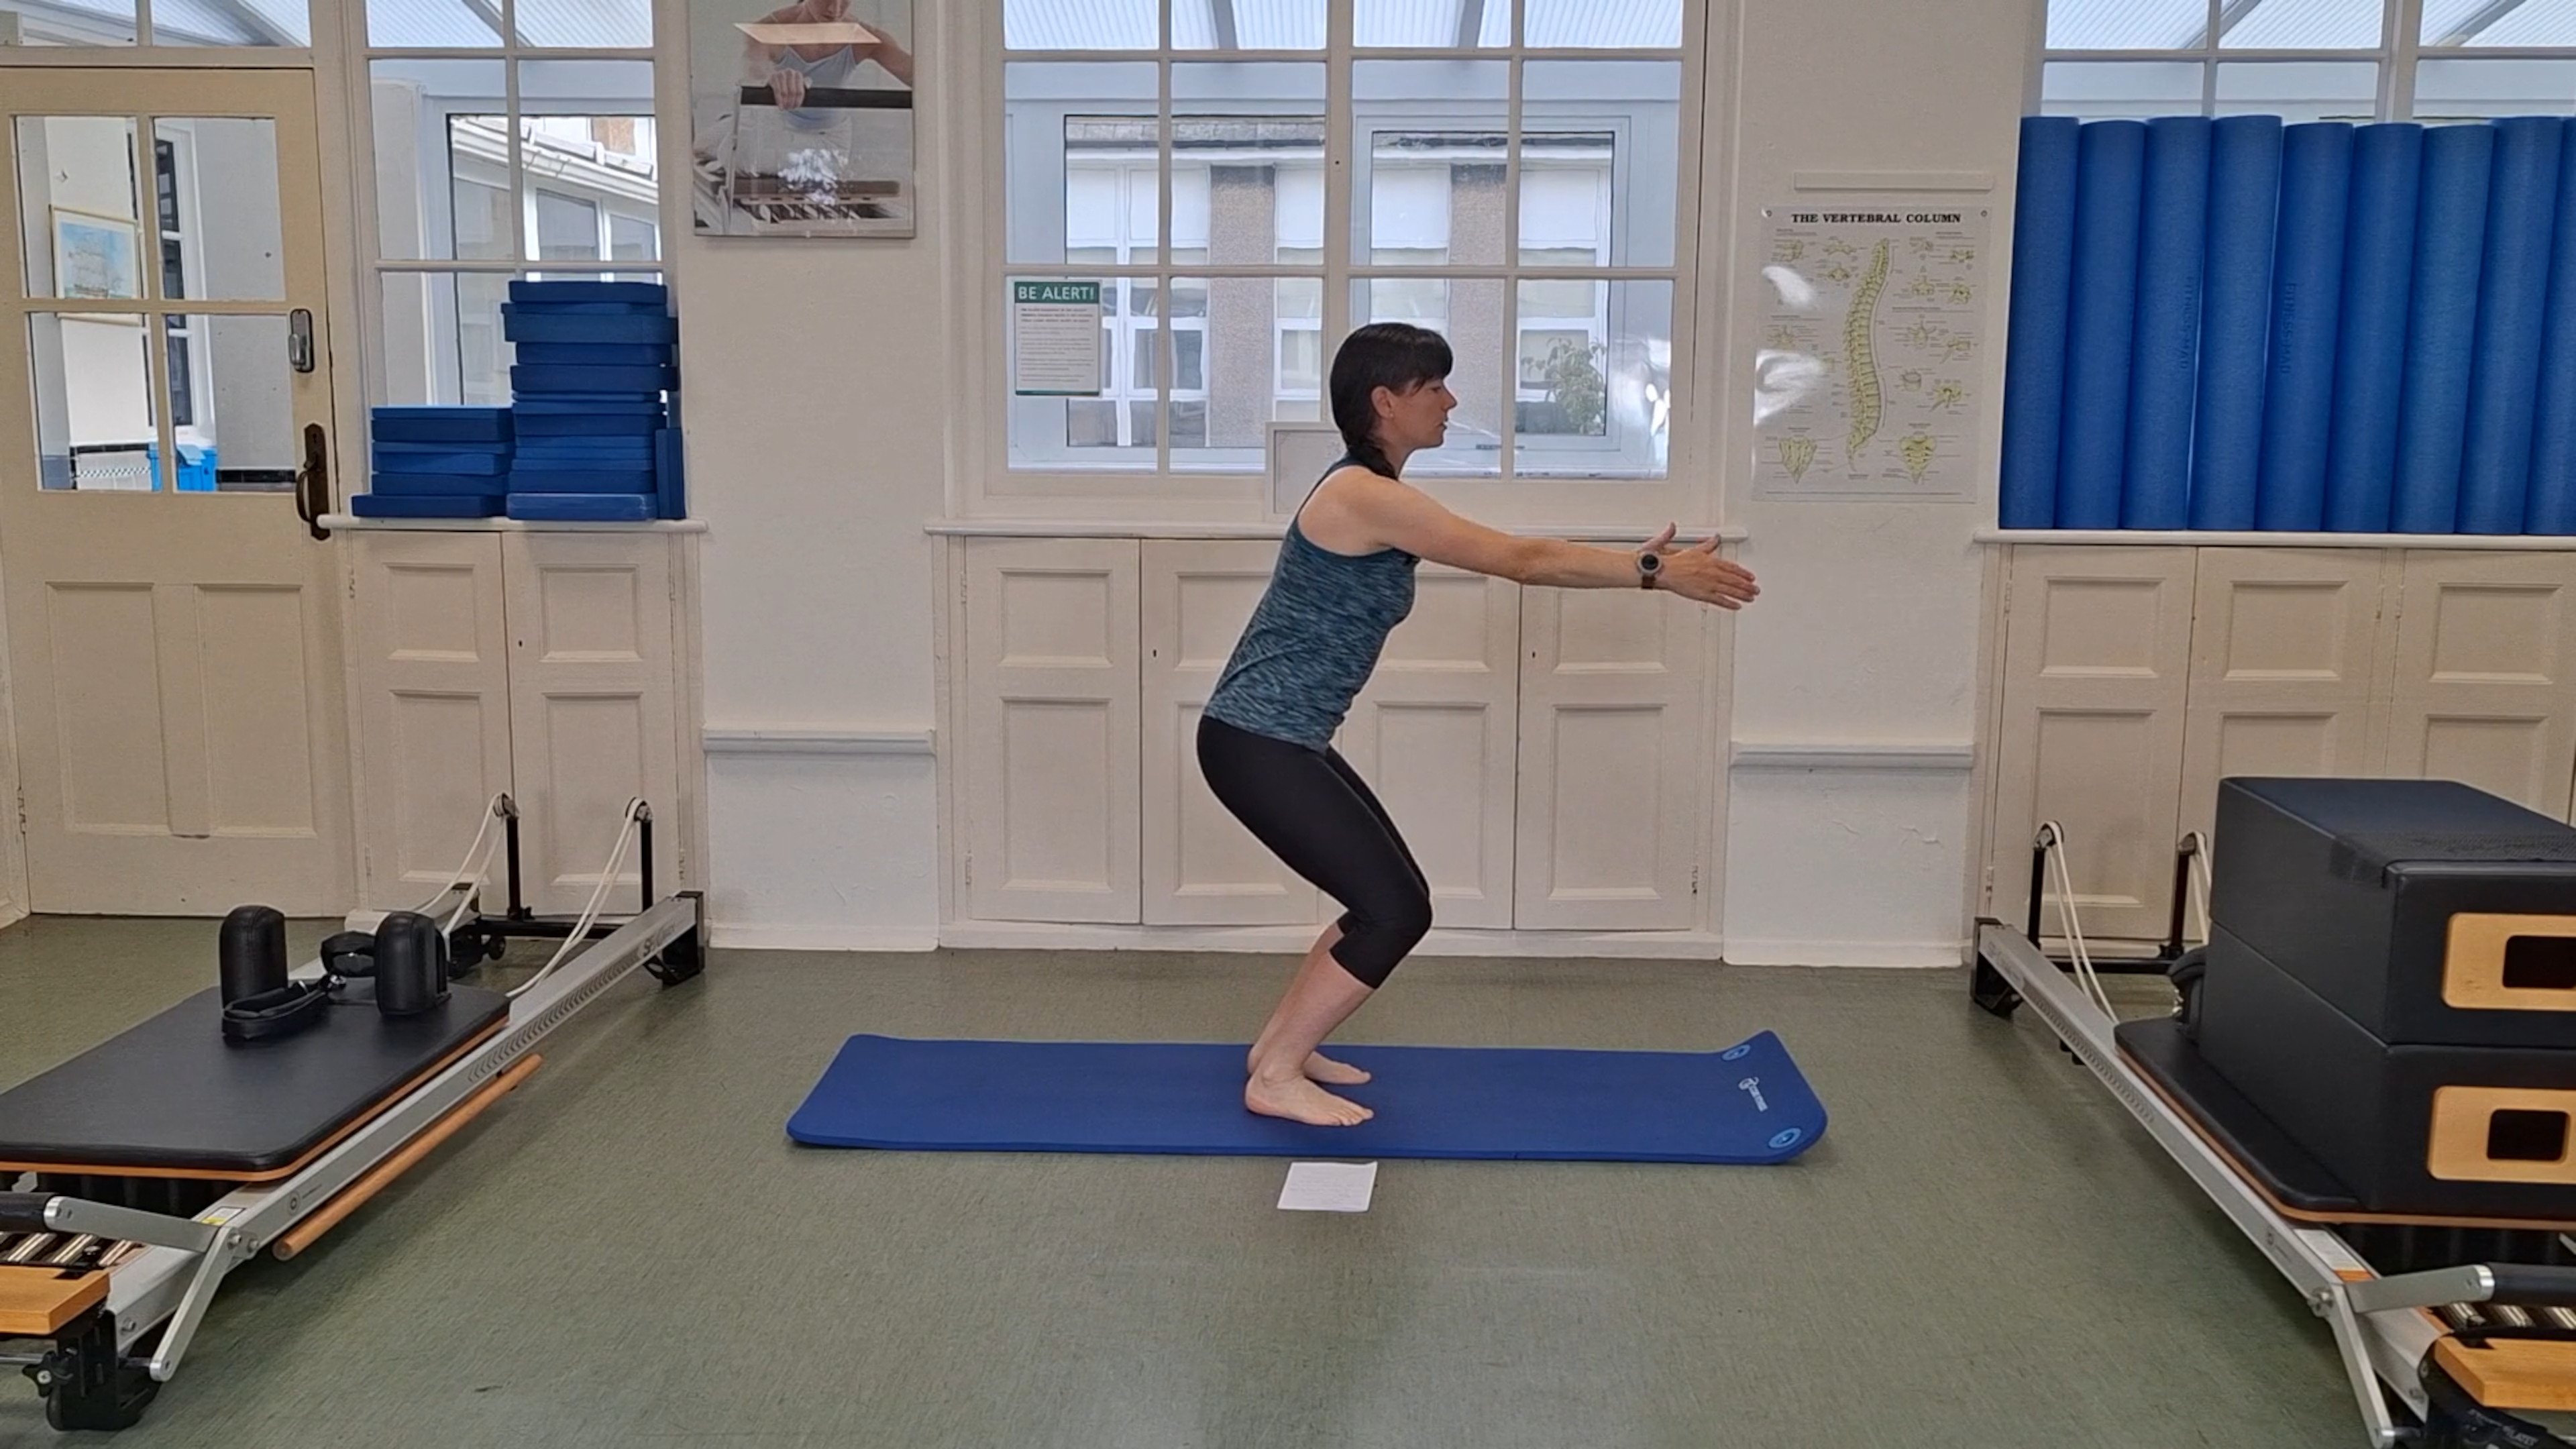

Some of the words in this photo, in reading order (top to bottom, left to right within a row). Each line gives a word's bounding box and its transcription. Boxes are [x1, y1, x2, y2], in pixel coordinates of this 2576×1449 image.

[1791, 213, 1819, 223] THE
[1823, 213, 1901, 223] VERTEBRAL
[1907, 213, 1962, 223] COLUMN
[1018, 286, 1037, 301] BE
[1042, 286, 1095, 301] ALERT!
